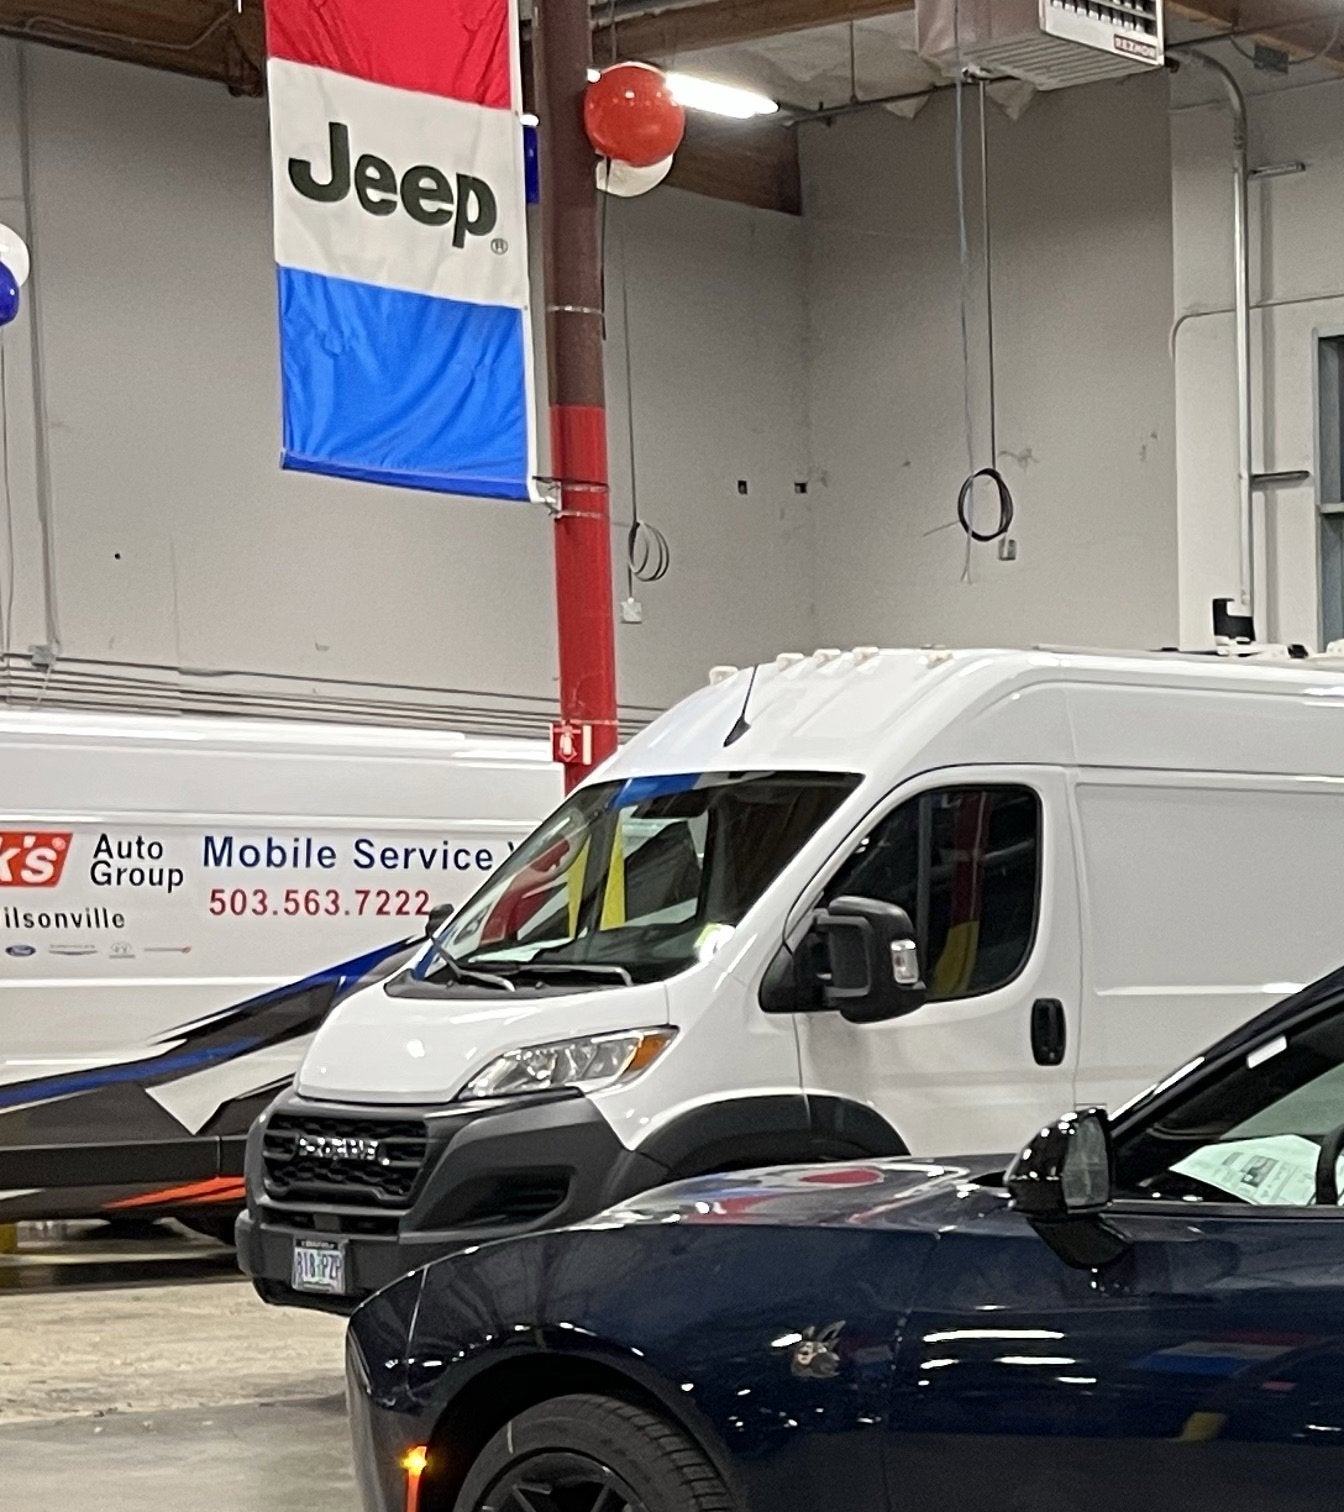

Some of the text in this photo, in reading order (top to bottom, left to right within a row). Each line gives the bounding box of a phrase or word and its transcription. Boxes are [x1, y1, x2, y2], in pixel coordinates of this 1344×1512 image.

[288, 121, 497, 249] Jeep
[92, 832, 164, 860] Auto
[203, 835, 494, 871] Mobile Service
[90, 860, 184, 894] Group
[209, 888, 431, 916] 503.563.7222
